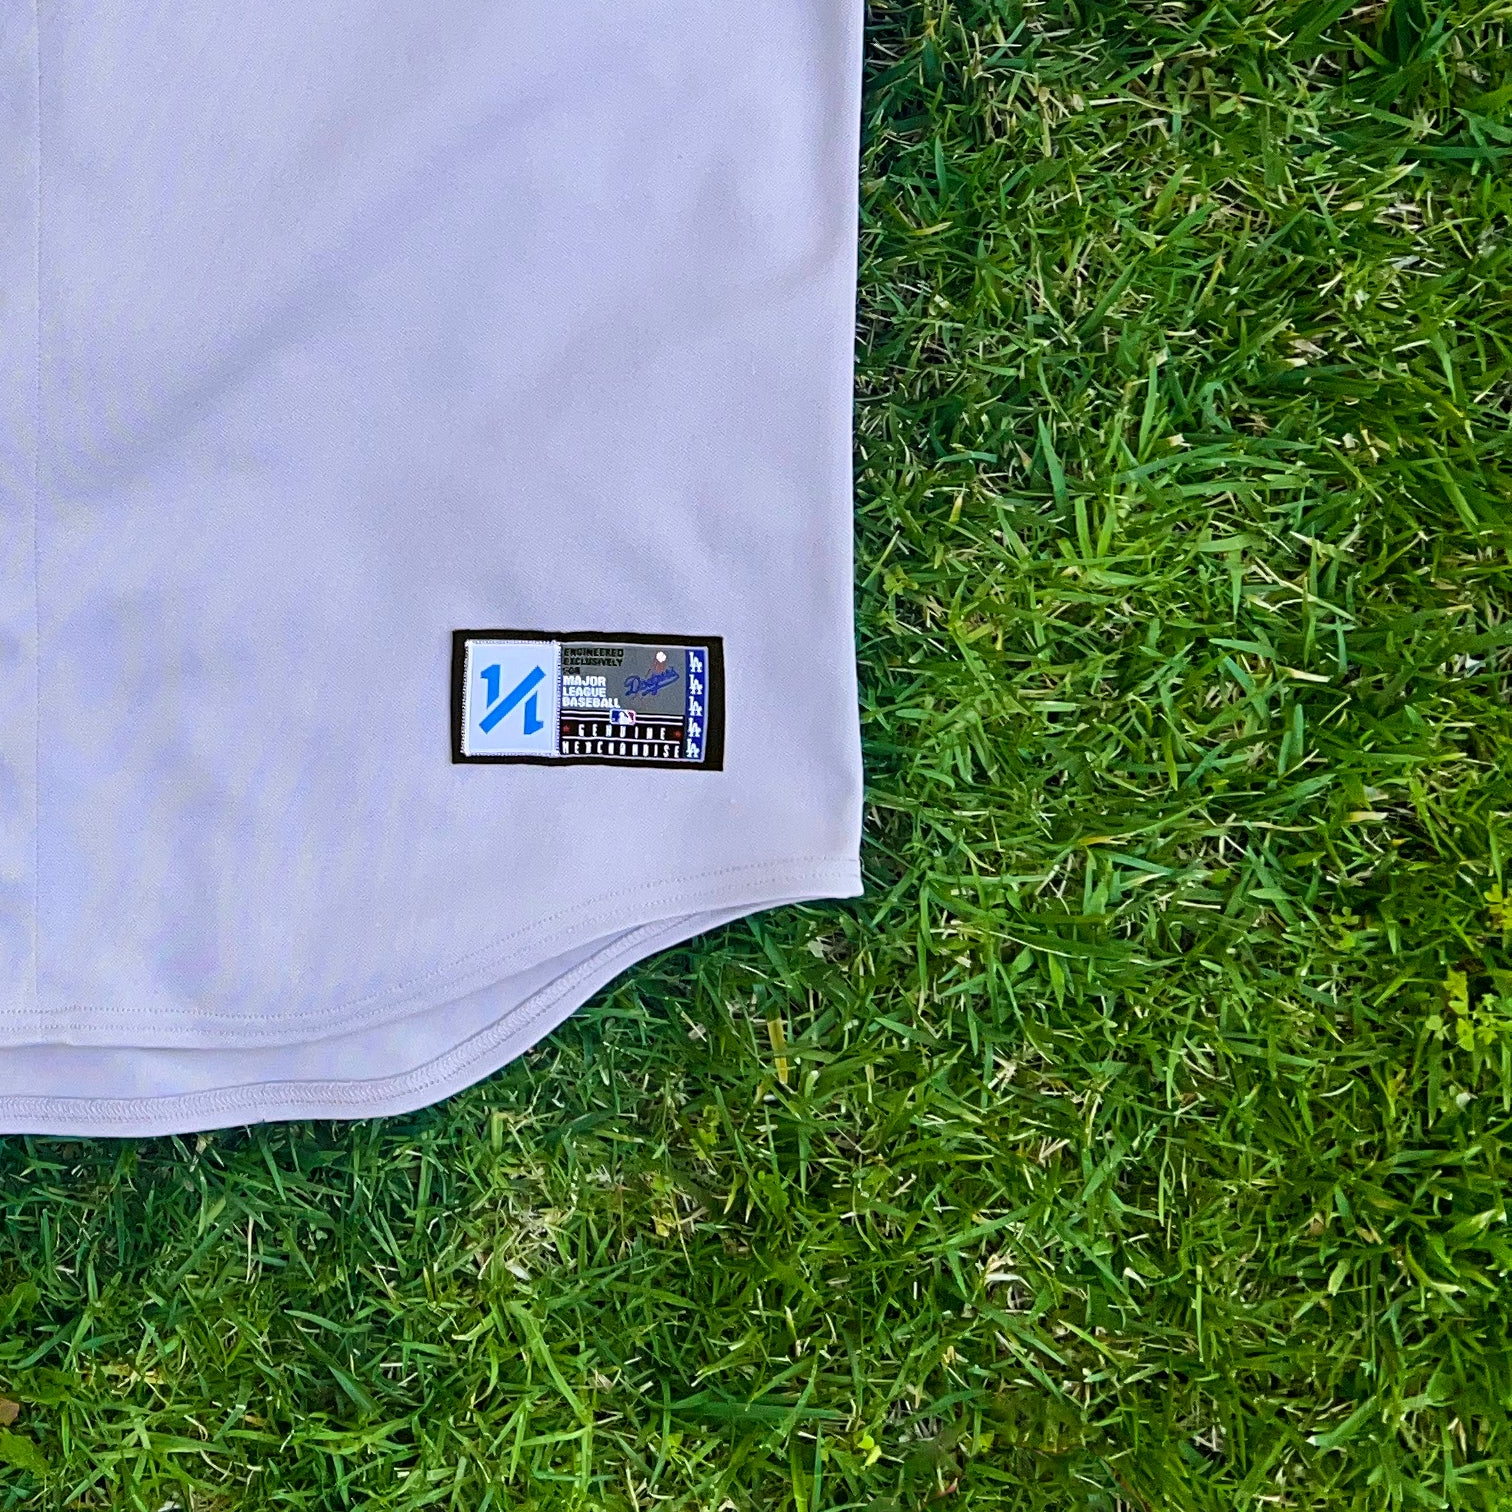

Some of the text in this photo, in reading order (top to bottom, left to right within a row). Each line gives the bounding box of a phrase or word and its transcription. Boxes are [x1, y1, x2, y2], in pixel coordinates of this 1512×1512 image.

[563, 648, 624, 657] ENGINEERED
[563, 657, 623, 667] EXCLUSIVELY
[562, 675, 607, 687] MAJOR
[562, 686, 607, 698] LEAGUE
[562, 697, 621, 708] BASEBALL
[578, 723, 666, 740] GENUINE
[562, 740, 680, 758] MERCHANDISE
